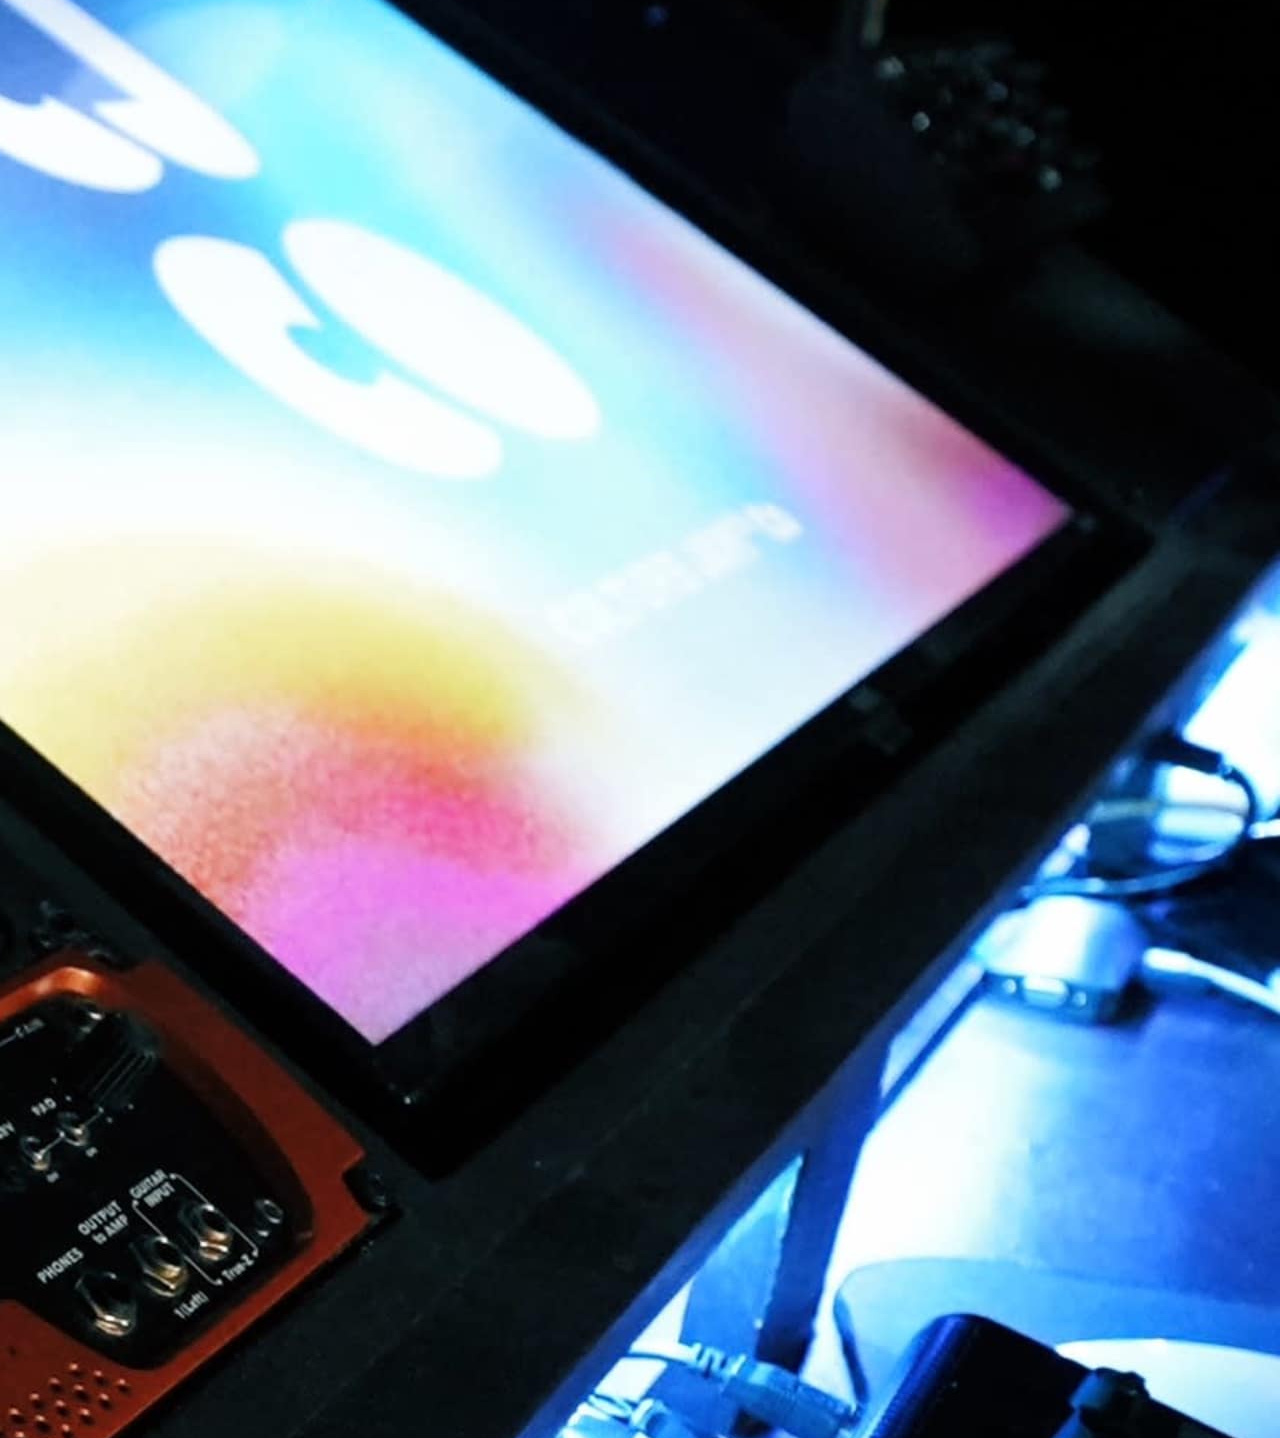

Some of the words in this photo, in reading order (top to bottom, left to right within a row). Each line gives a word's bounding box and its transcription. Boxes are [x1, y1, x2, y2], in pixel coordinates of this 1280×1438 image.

[128, 1168, 169, 1200] GUITAR
[143, 1182, 176, 1209] INPUT
[76, 1200, 123, 1237] OUTPUT
[103, 1214, 130, 1240] AMP
[36, 1246, 85, 1285] PHONES
